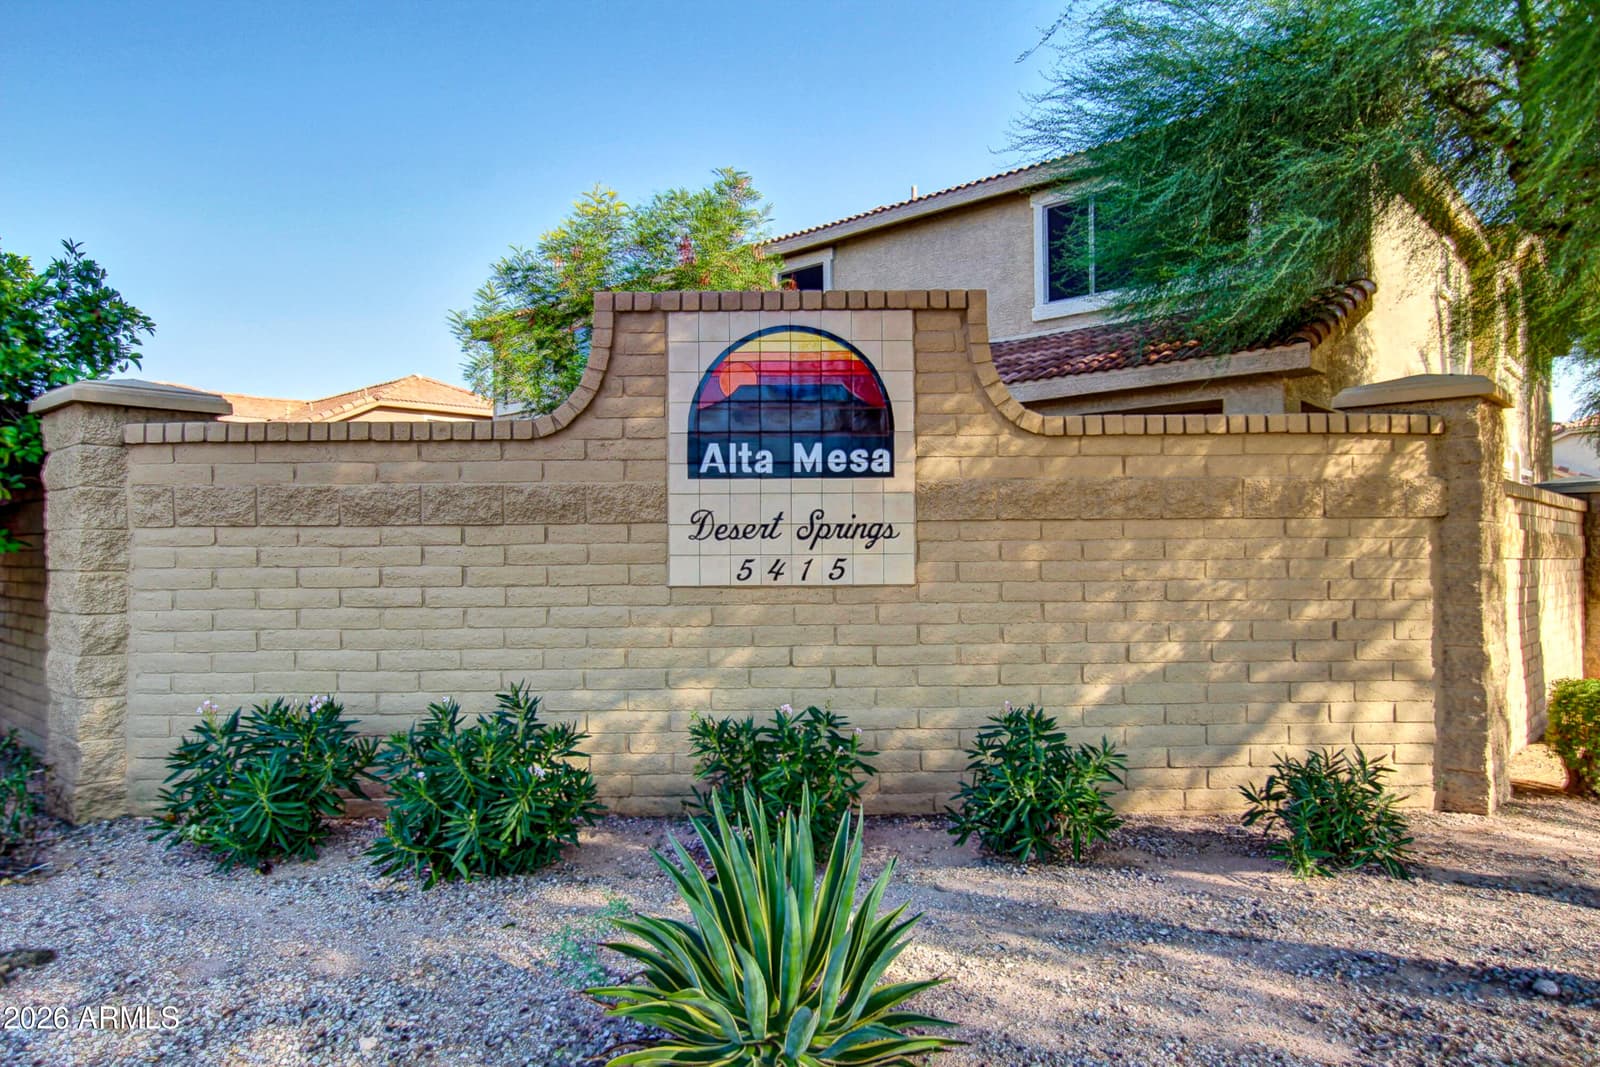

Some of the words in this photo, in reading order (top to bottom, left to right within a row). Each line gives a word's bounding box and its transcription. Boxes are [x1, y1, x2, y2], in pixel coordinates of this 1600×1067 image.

[699, 442, 774, 474] Alta
[793, 442, 891, 474] Mesa
[688, 508, 784, 542] Desert
[796, 508, 900, 550] Springs
